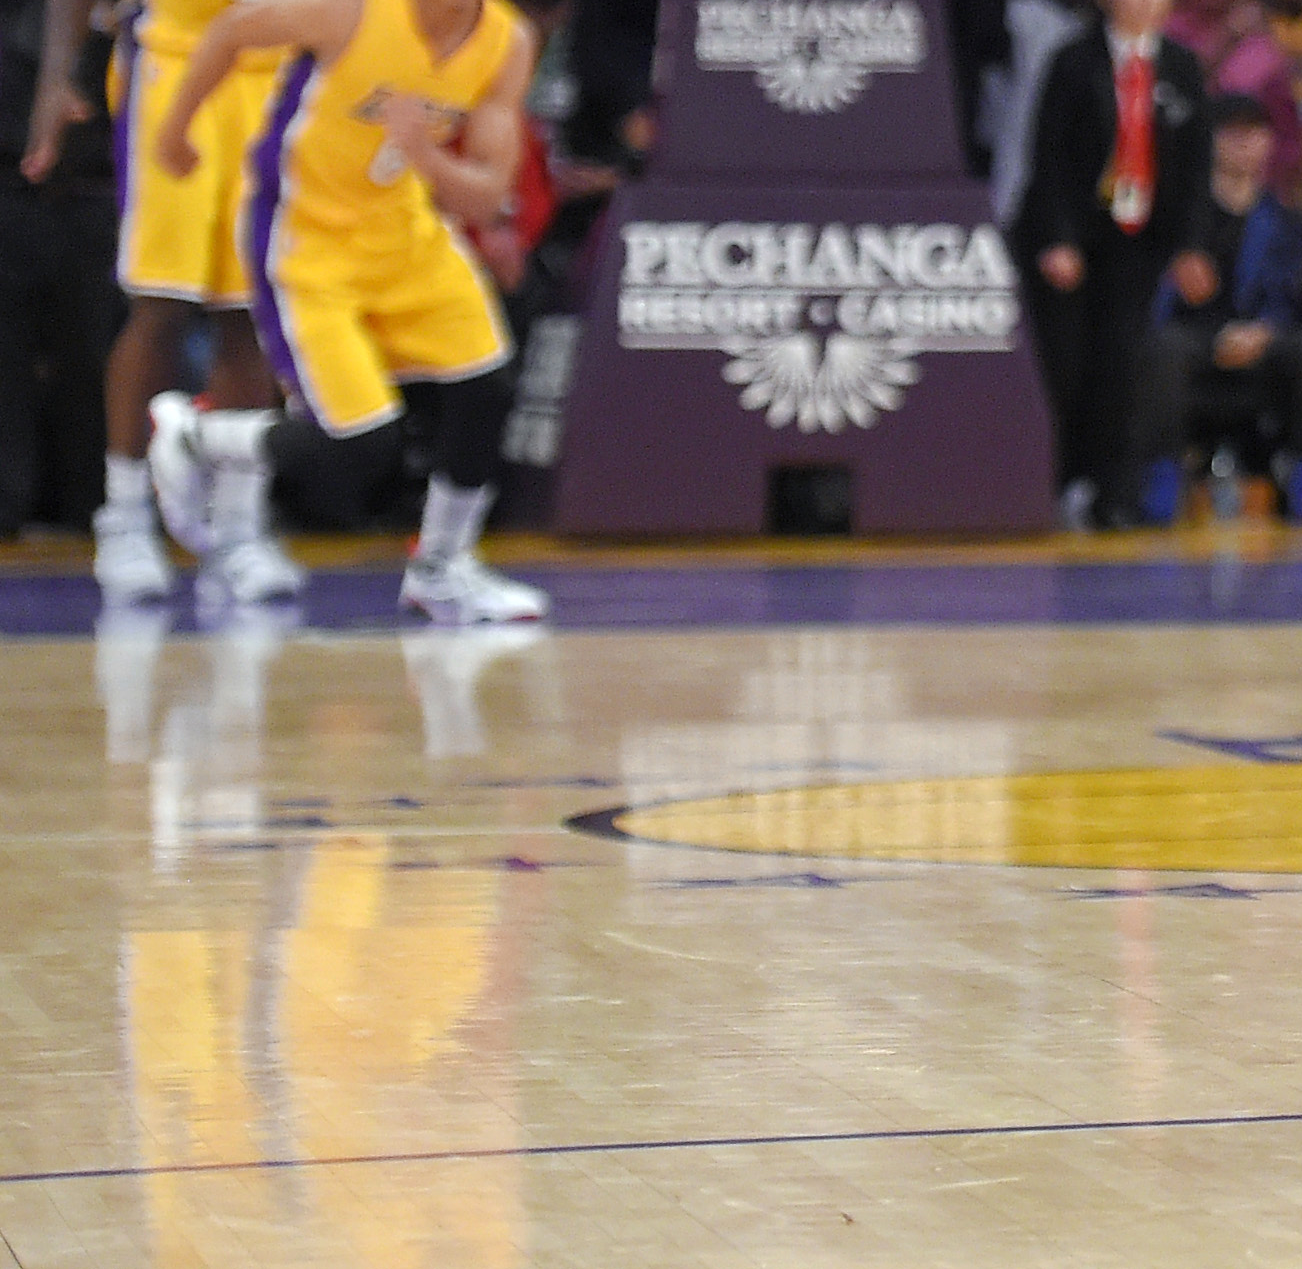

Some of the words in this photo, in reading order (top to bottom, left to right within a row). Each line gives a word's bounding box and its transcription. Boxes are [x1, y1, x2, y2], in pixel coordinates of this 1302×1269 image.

[621, 222, 1018, 286] PECHANGA
[618, 291, 799, 334] RESORT
[838, 291, 1020, 335] CASINO
